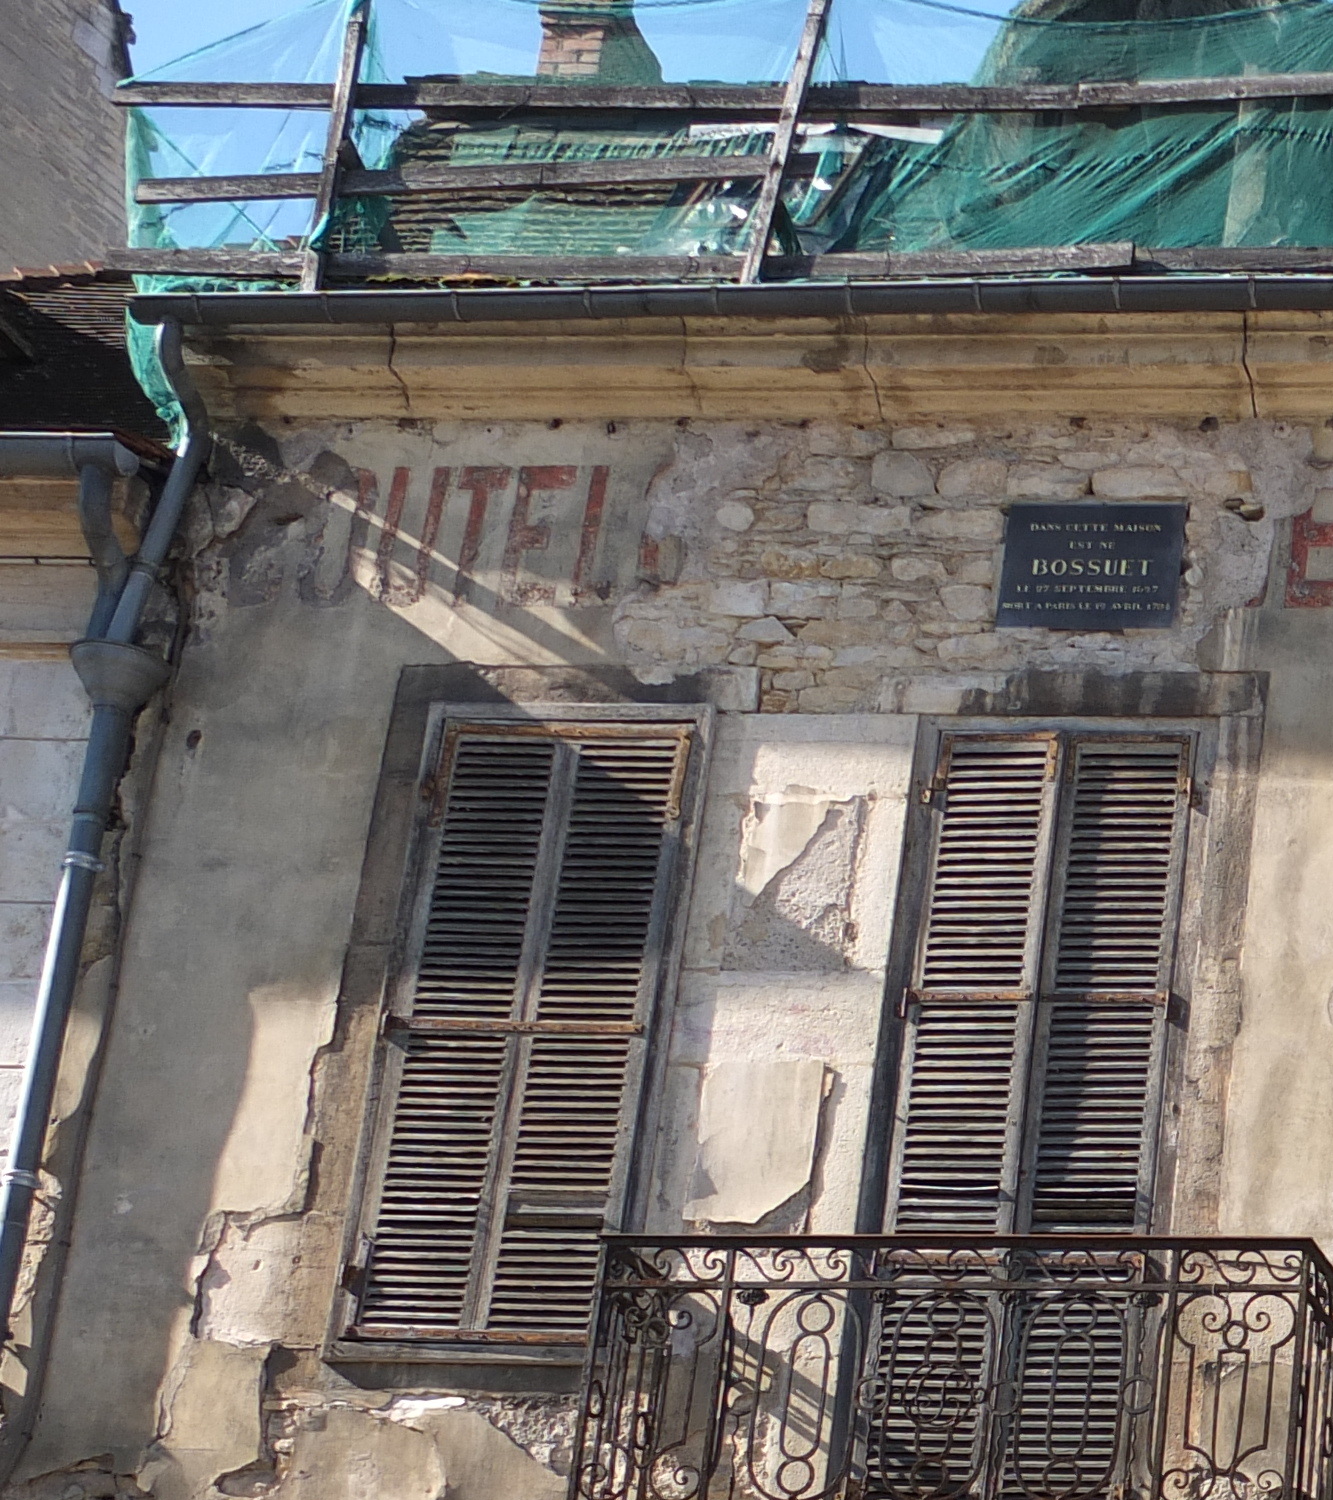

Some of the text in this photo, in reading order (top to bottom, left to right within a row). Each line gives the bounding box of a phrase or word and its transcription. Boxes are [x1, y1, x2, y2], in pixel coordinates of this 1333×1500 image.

[1030, 522, 1162, 532] DANS CETTE MAISON
[1069, 541, 1093, 550] EST
[1031, 558, 1154, 576] BOSSUET
[1053, 584, 1127, 593] SEPTEMBRE
